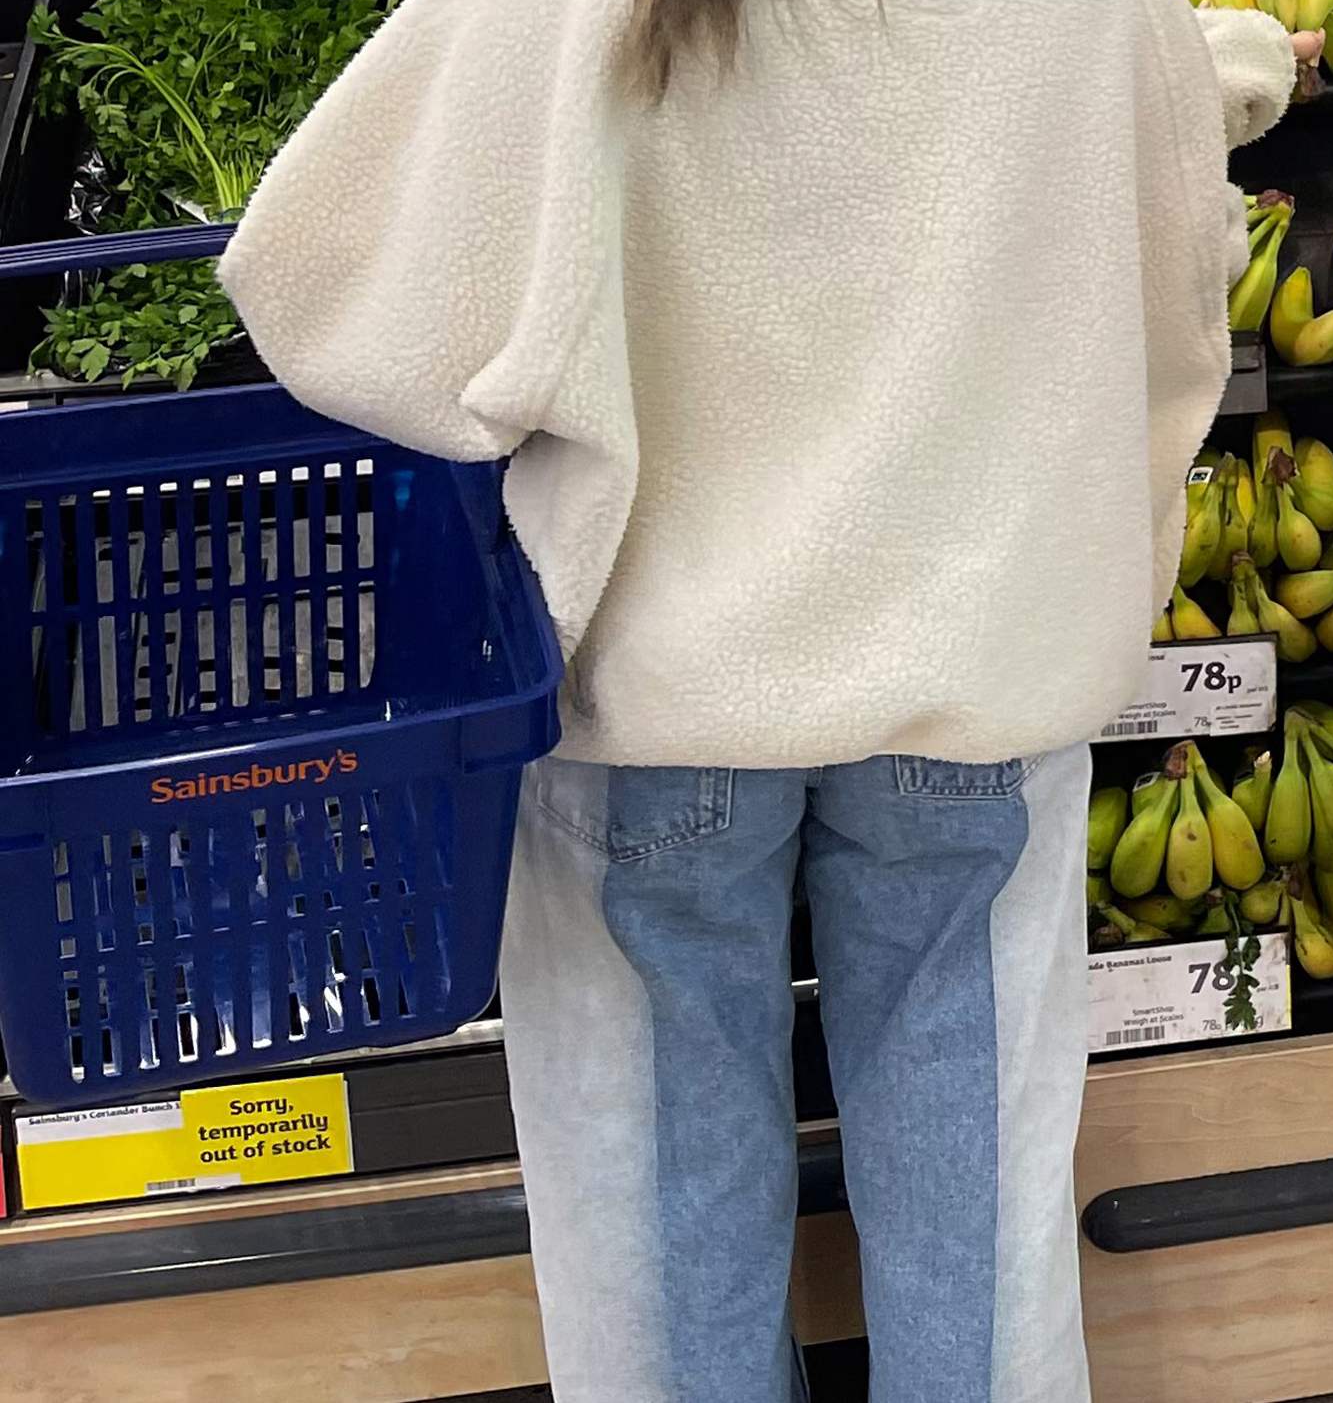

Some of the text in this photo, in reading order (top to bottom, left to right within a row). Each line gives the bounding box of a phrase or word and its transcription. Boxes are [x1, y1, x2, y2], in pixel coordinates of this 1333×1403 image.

[1181, 662, 1242, 693] 78p
[151, 749, 358, 803] Sainsbury's
[29, 1103, 173, 1125] Sainsbury's Coriander Bunch
[230, 1097, 294, 1116] Sorry,
[198, 1114, 329, 1142] temporarily
[200, 1134, 331, 1163] out of stock
